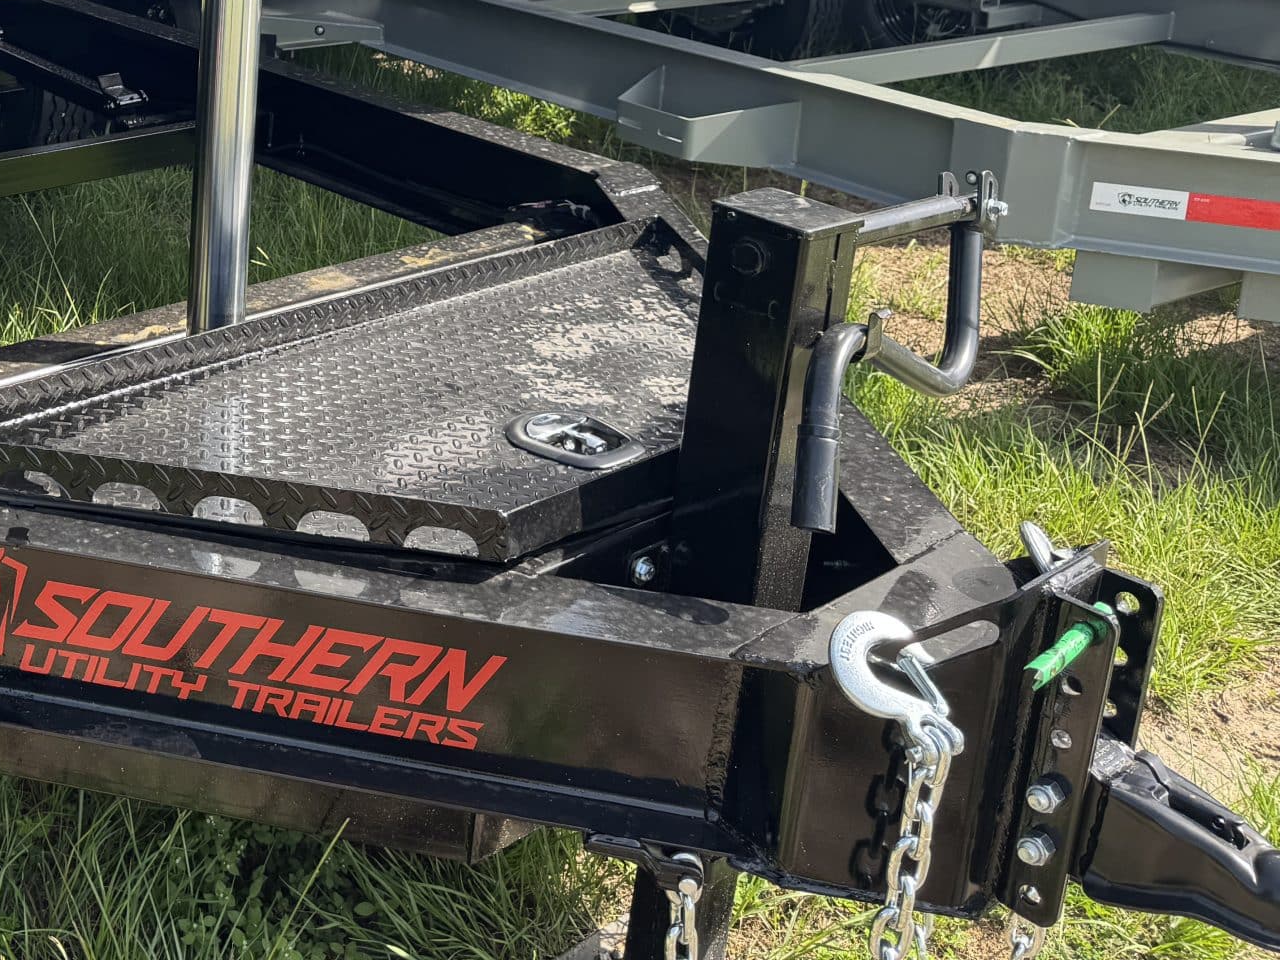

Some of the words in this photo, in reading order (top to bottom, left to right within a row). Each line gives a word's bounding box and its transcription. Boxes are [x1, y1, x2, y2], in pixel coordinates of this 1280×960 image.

[12, 580, 508, 713] SOUTHERN
[20, 645, 208, 700] UTILITY
[227, 679, 484, 751] TRAILERS
